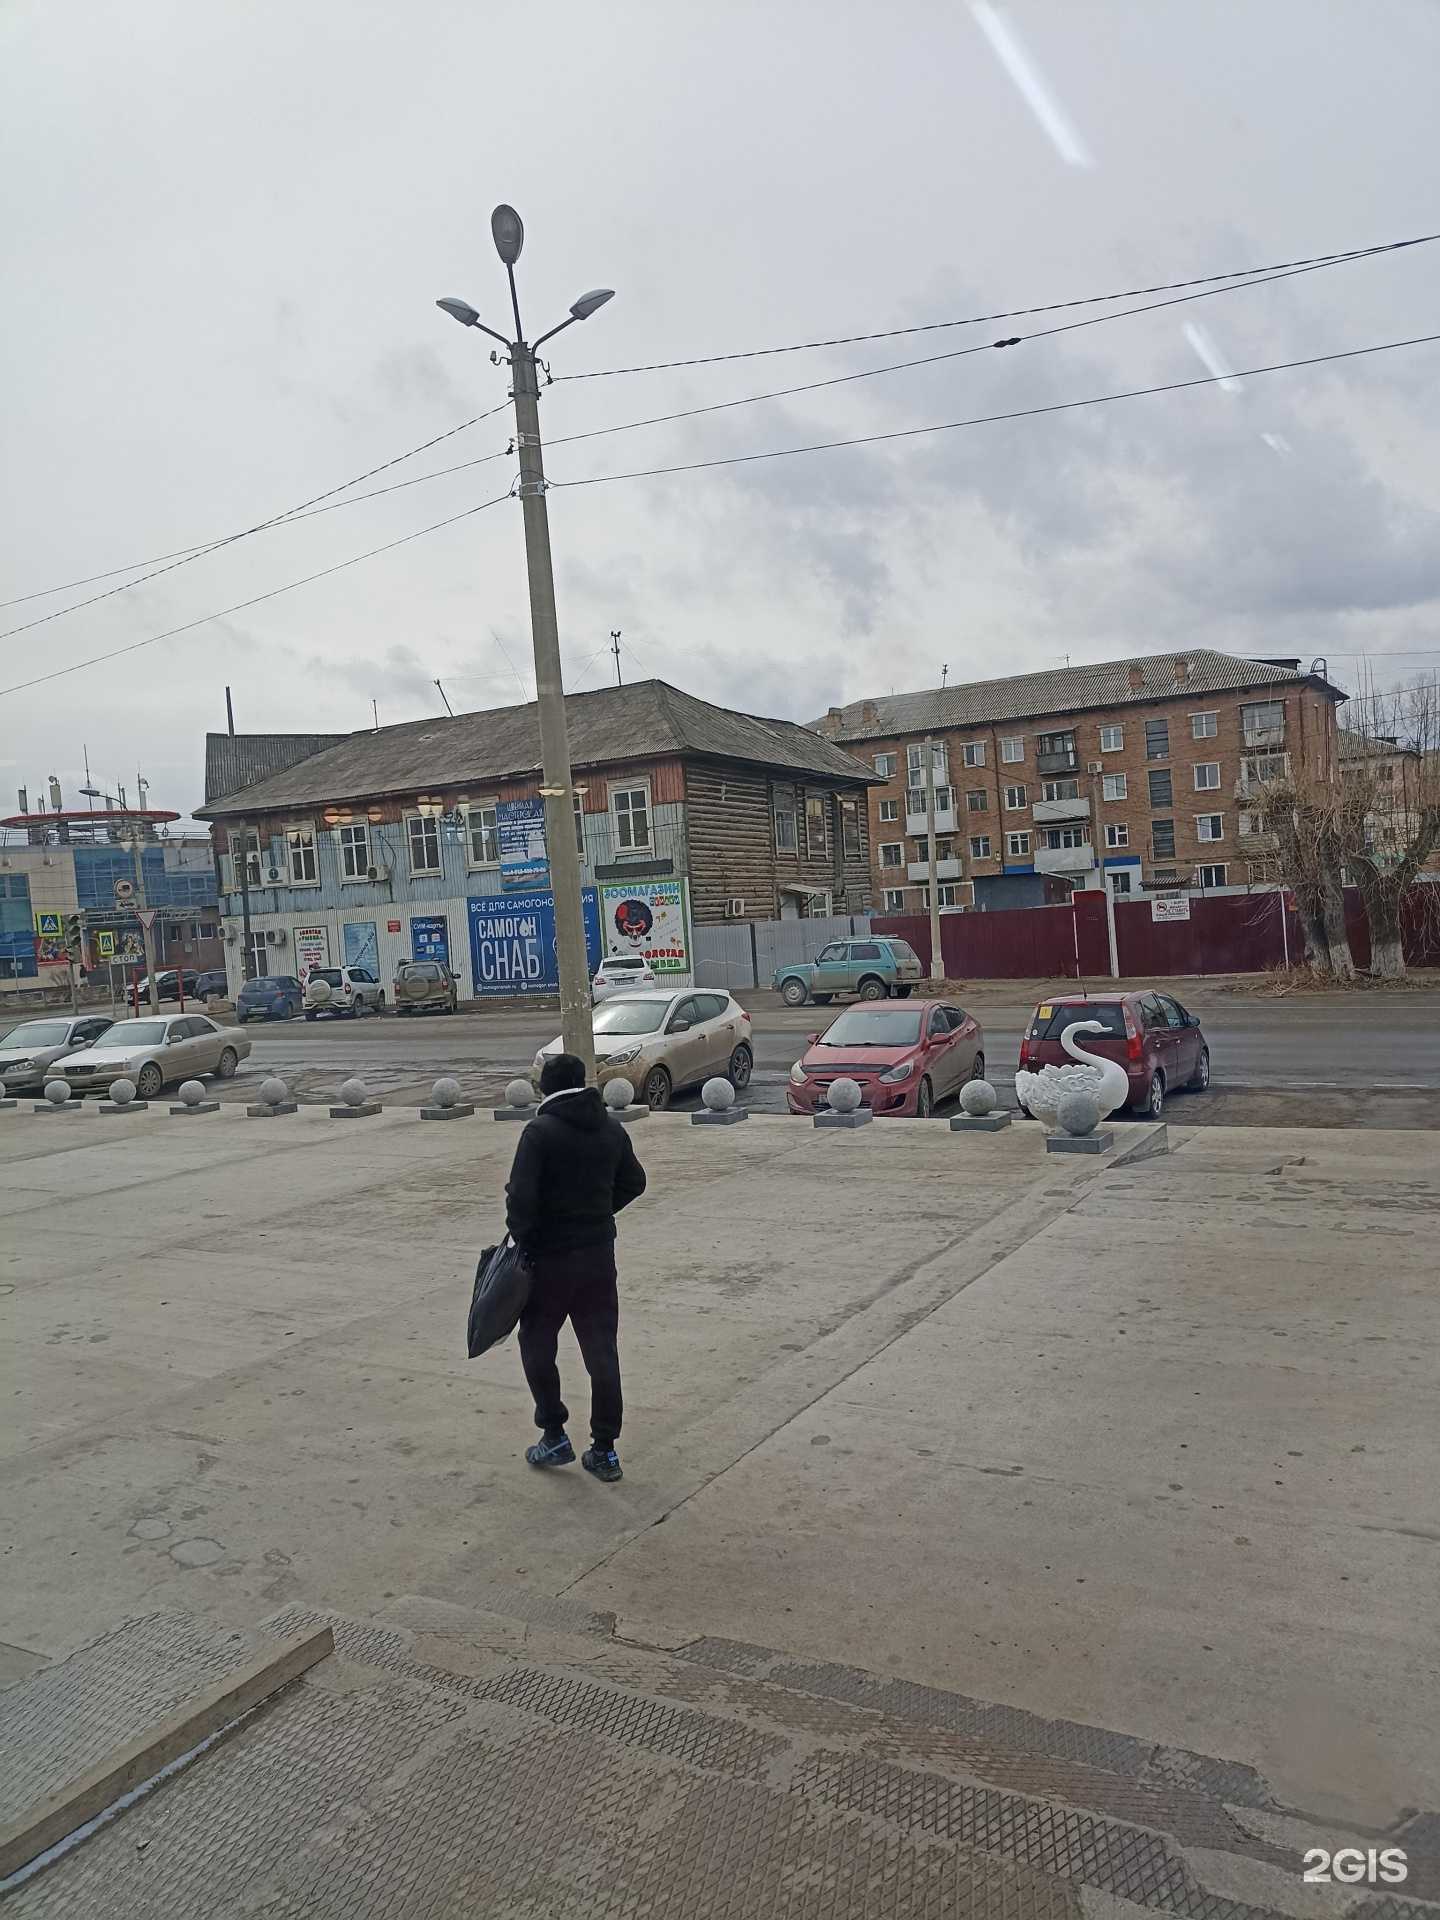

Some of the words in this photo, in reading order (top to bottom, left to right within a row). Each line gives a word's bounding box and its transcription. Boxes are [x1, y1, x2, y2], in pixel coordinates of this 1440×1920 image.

[604, 883, 680, 899] ЗООМАГАЗИН
[471, 903, 486, 912] ВСЕ
[489, 902, 504, 912] ДЛЯ
[478, 916, 537, 939] САМОГОН
[480, 939, 541, 980] СНАБ
